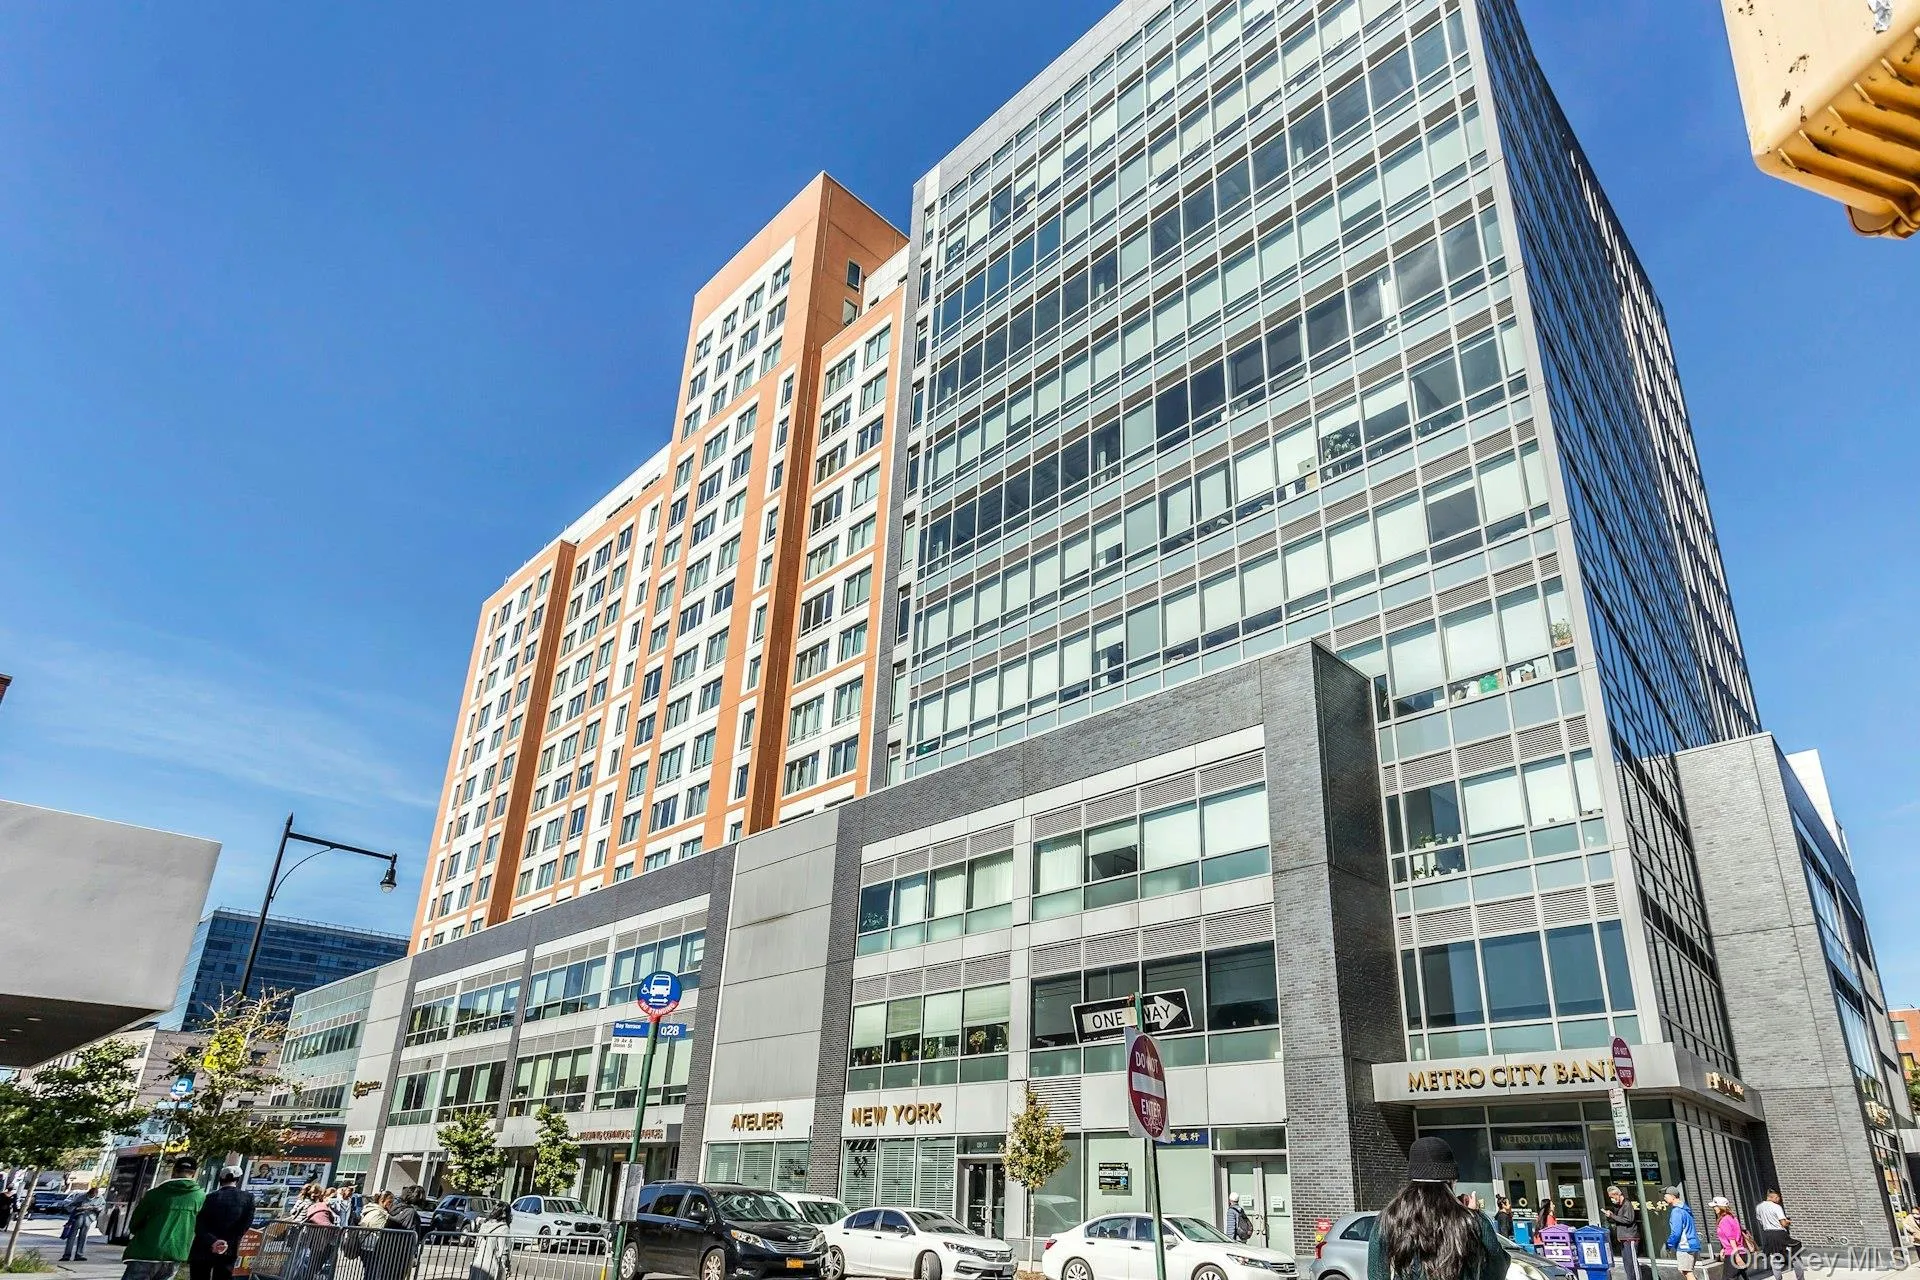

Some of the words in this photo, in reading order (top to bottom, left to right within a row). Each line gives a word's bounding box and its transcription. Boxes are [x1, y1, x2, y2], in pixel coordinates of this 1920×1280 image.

[649, 1002, 677, 1015] STANDING
[1092, 1011, 1125, 1029] ONE
[661, 1025, 679, 1036] Q28
[1135, 1051, 1145, 1069] DO
[1146, 1054, 1159, 1074] NOT
[1408, 1067, 1486, 1092] METRO
[1490, 1063, 1547, 1088] CITY
[1619, 1069, 1632, 1078] ENTER
[851, 1106, 888, 1127] NEW
[893, 1102, 942, 1126] YORK
[1140, 1098, 1163, 1118] ENTER
[731, 1111, 784, 1132] ATELIER
[1500, 1134, 1531, 1144] METRO
[1532, 1133, 1554, 1143] CITY
[1556, 1133, 1583, 1143] BANK
